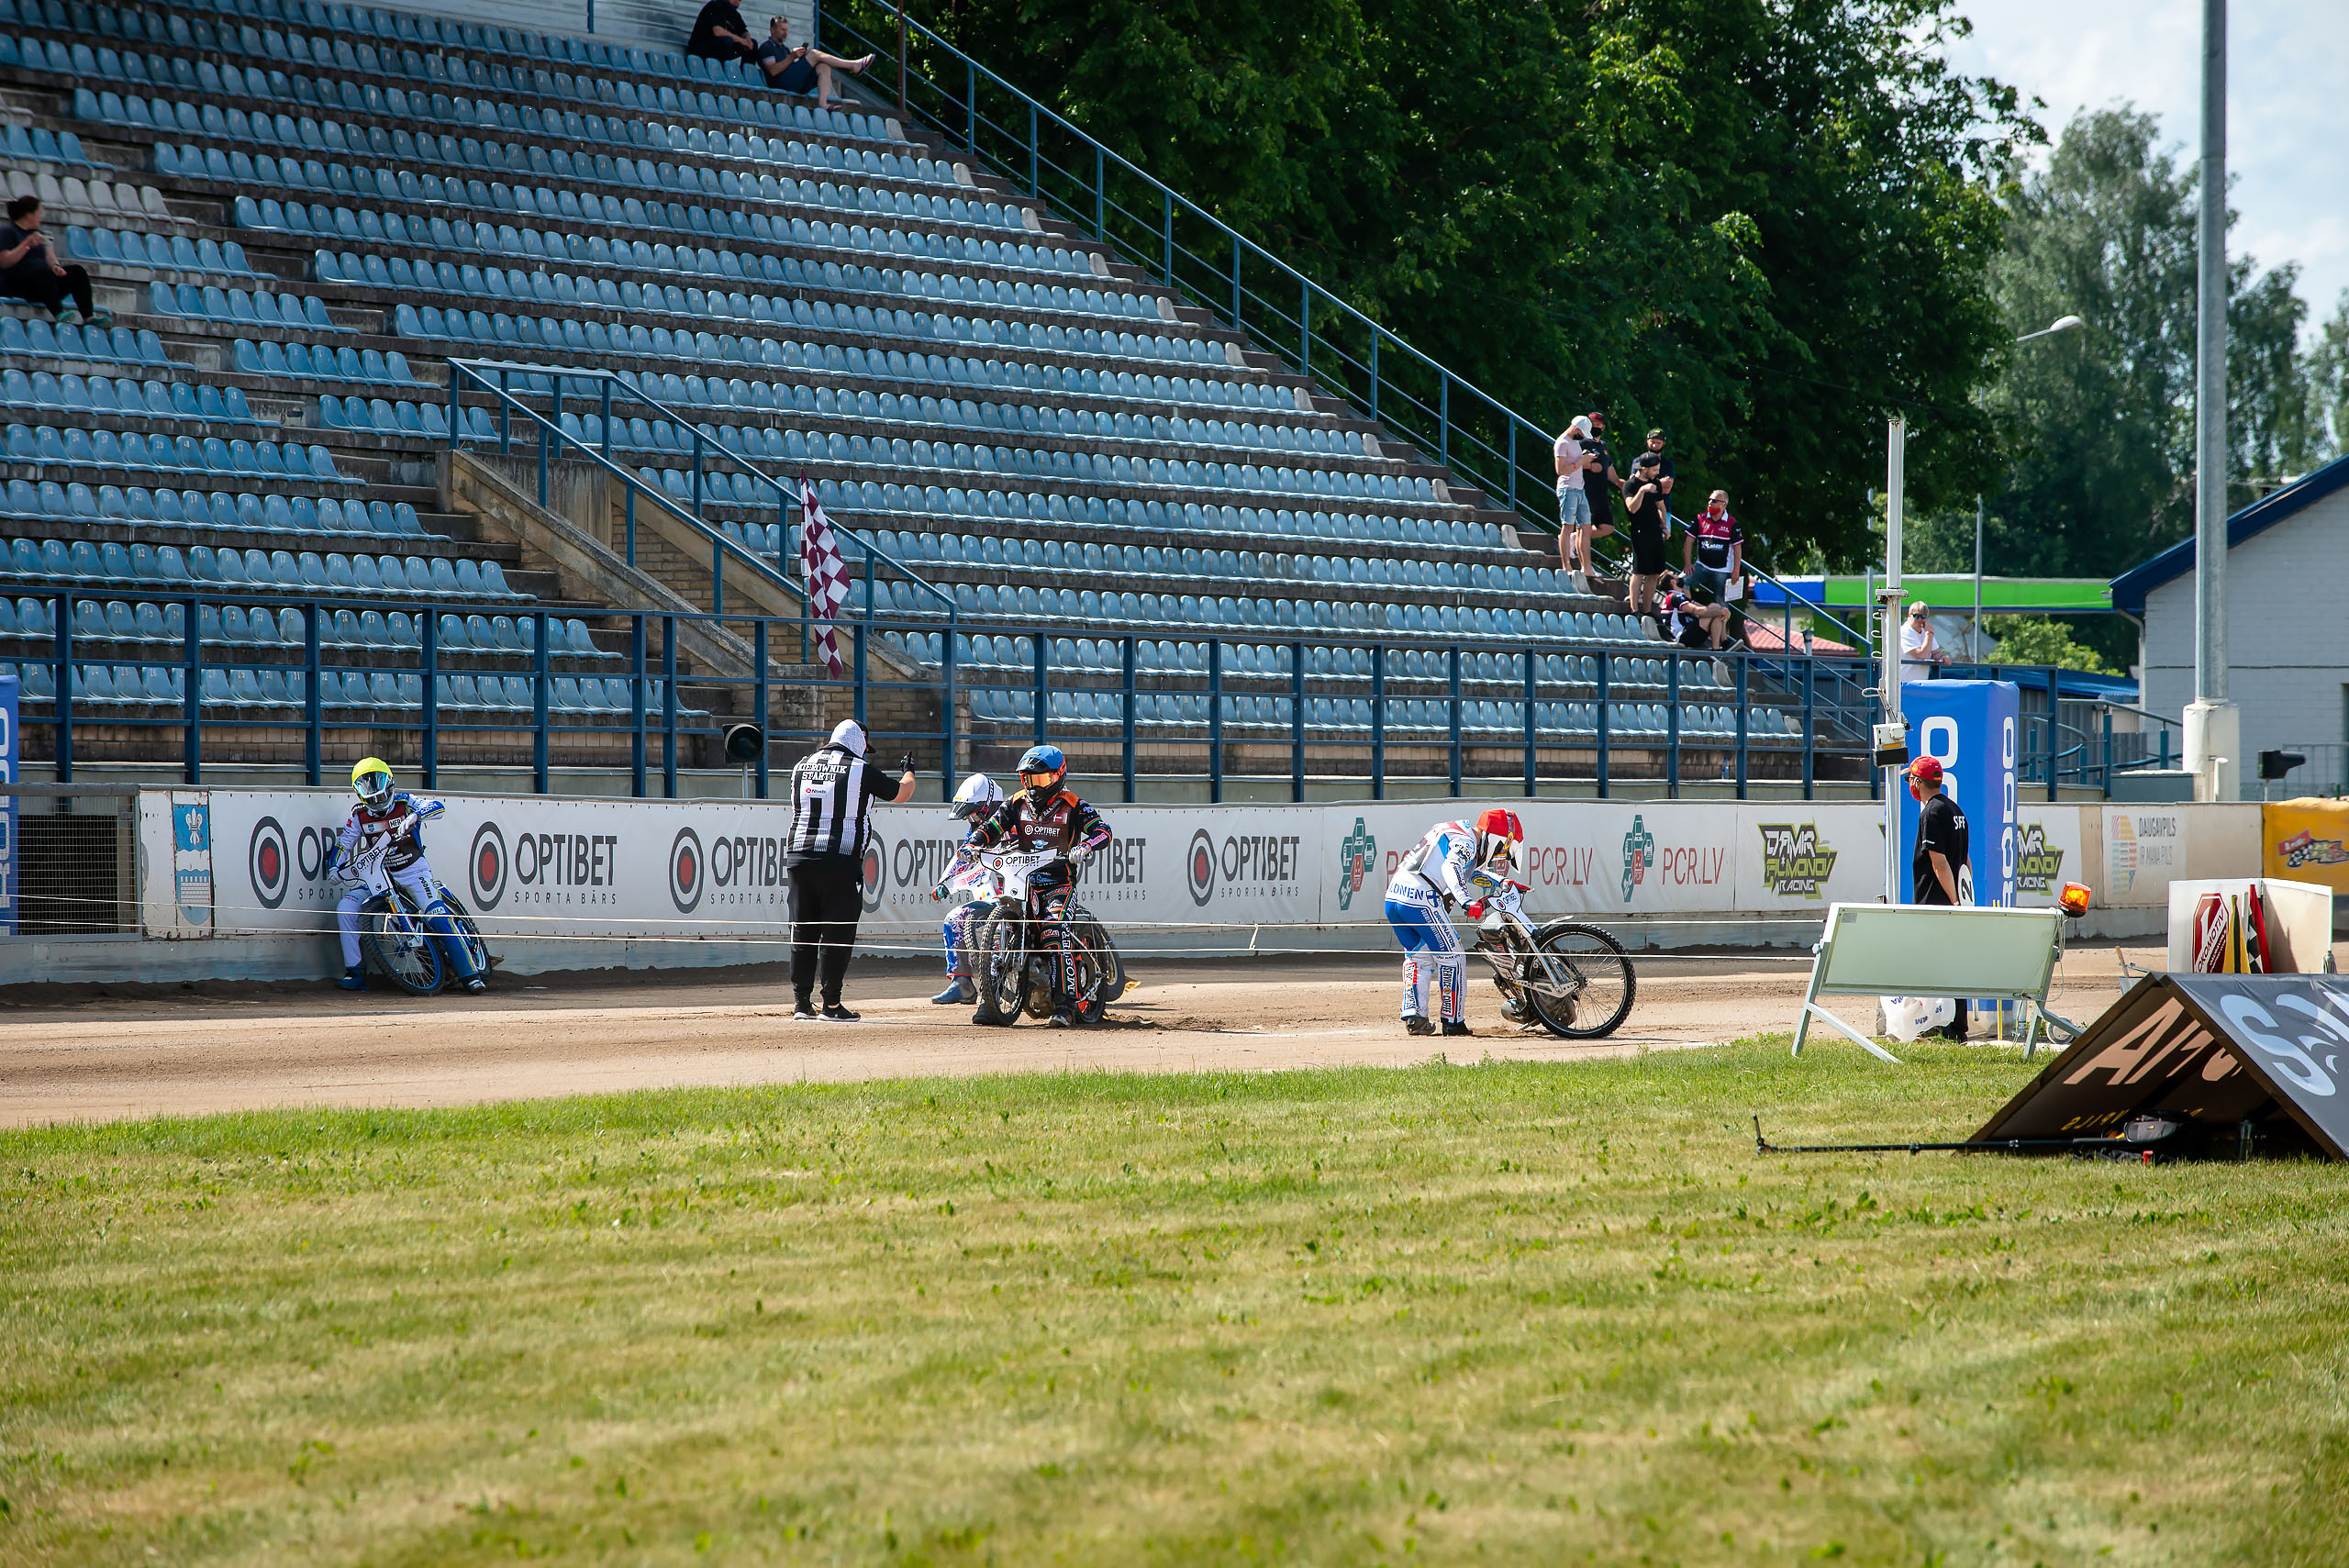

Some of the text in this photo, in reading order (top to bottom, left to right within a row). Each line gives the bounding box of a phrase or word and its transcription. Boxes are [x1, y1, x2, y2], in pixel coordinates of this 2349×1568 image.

[802, 772, 837, 782] STARTU
[354, 845, 383, 871] OPTIBET
[515, 833, 618, 885] OPTIBET
[711, 836, 787, 887] OPTIBE
[1005, 855, 1041, 865] OPTIBET
[1221, 835, 1300, 882] OPTIBET
[1529, 846, 1593, 885] PCR.LV
[1662, 847, 1725, 885] PCR.LV
[1221, 884, 1299, 897] SPORTA BĀRS
[1778, 879, 1814, 892] RACING
[515, 889, 617, 905] SPORTA BĀRS
[710, 893, 763, 905] SPORTA
